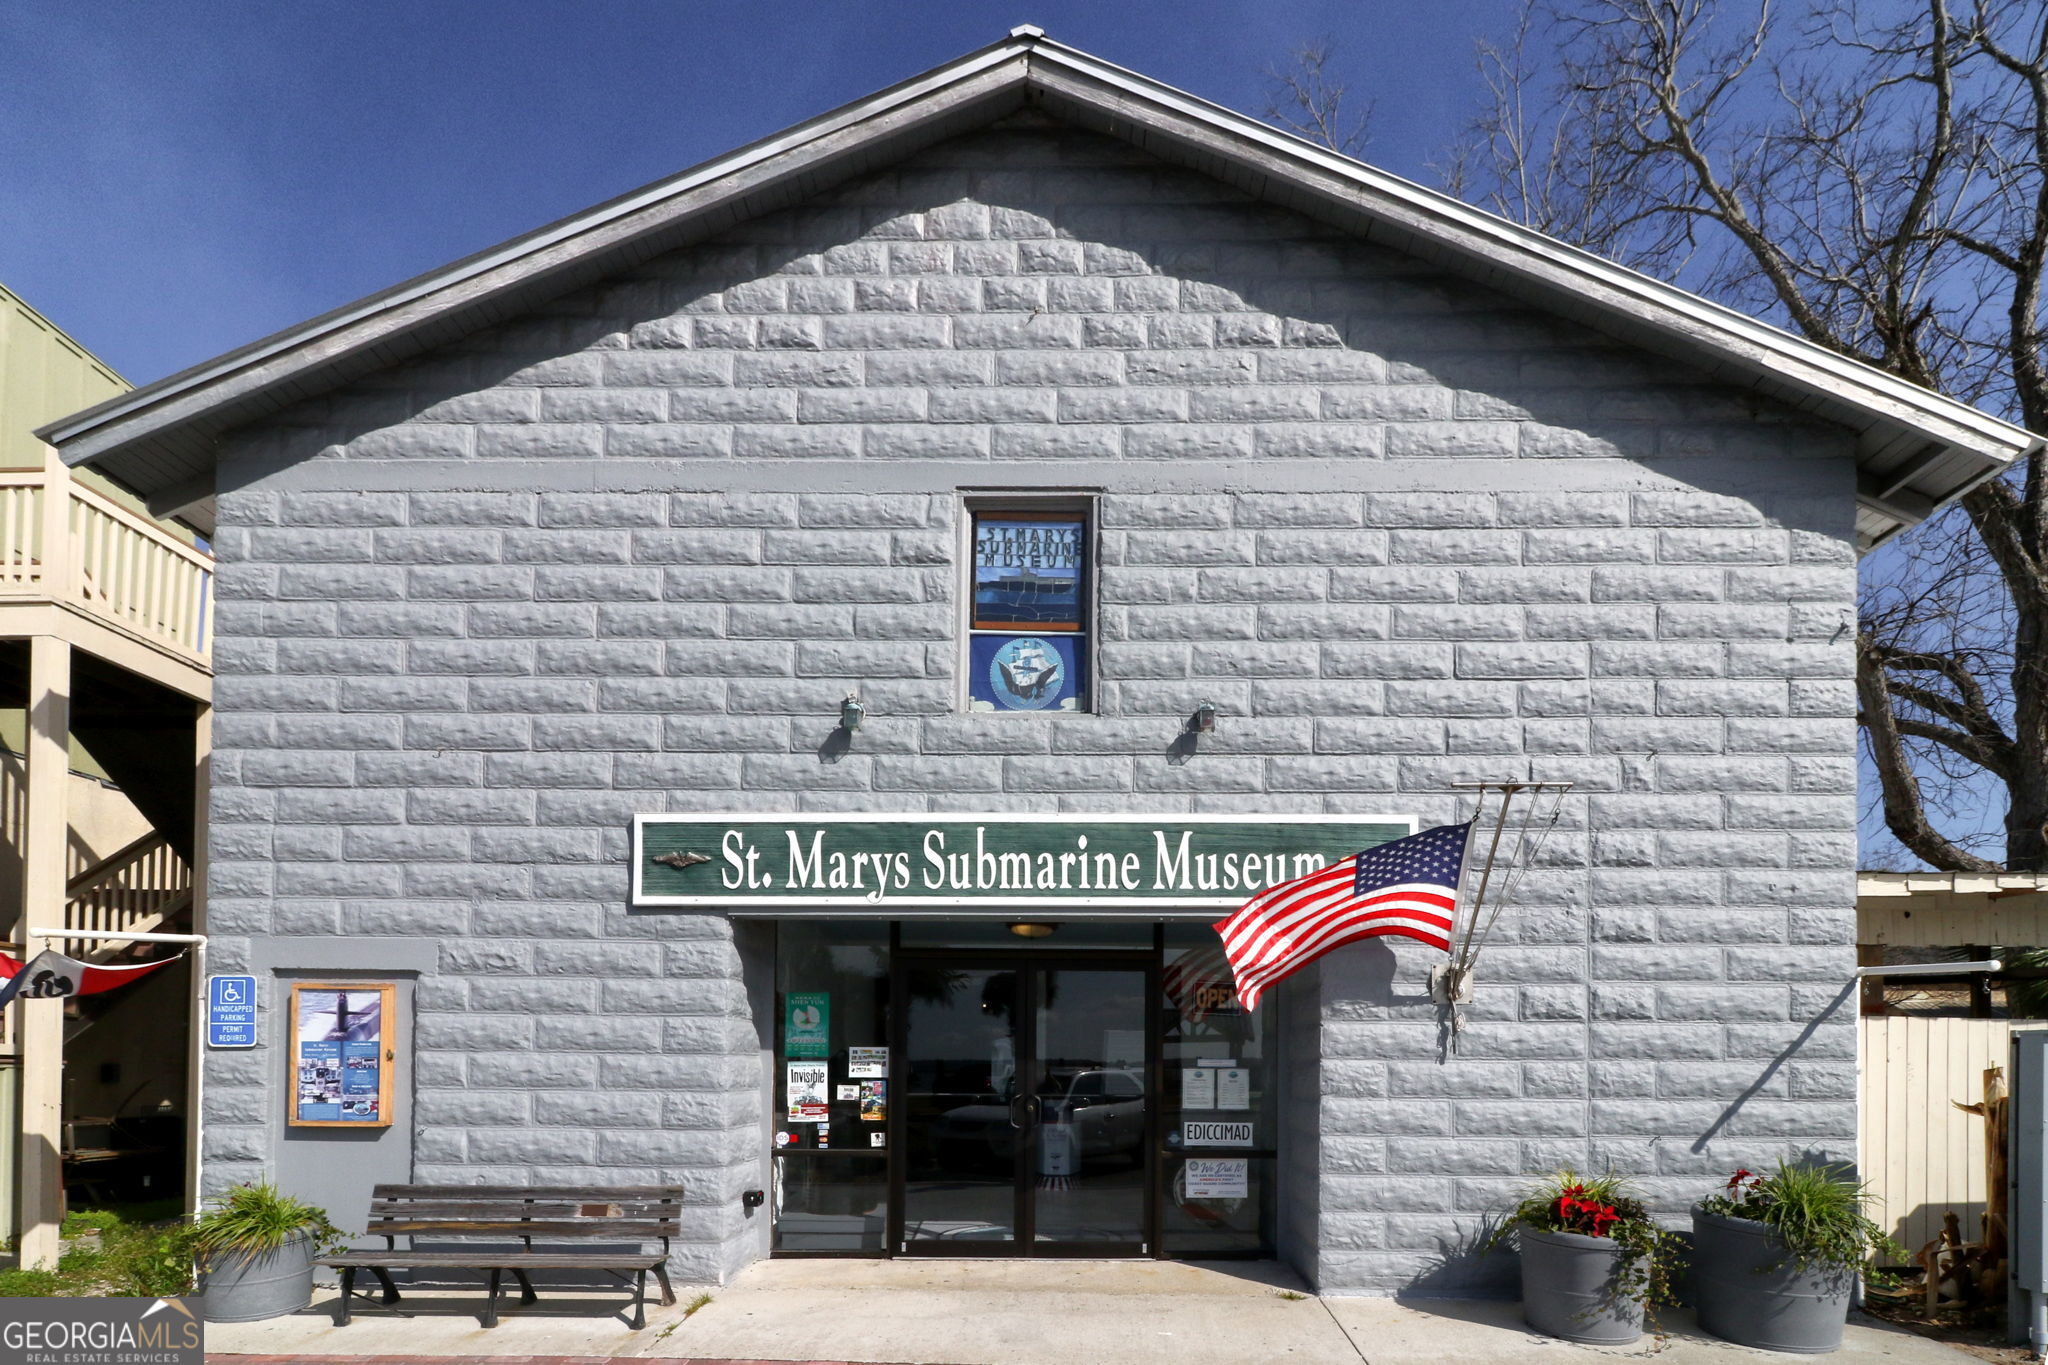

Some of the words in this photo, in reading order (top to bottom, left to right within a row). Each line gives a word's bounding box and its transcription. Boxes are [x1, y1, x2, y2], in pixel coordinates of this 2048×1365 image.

[977, 541, 1082, 556] SUBMARINE
[985, 554, 1075, 568] MUSEUM
[721, 829, 772, 889] St.
[785, 829, 910, 904] Marys
[923, 826, 1141, 890] Submarine
[212, 1005, 253, 1013] HANDICAPPED
[220, 1014, 246, 1022] PARKING
[222, 1025, 243, 1033] PERMIT
[218, 1034, 247, 1042] REQUIRED
[790, 1068, 825, 1083] Invisible
[1186, 1123, 1250, 1141] EDICCIMAD
[1200, 1162, 1215, 1173] We
[1215, 1162, 1233, 1174] Did
